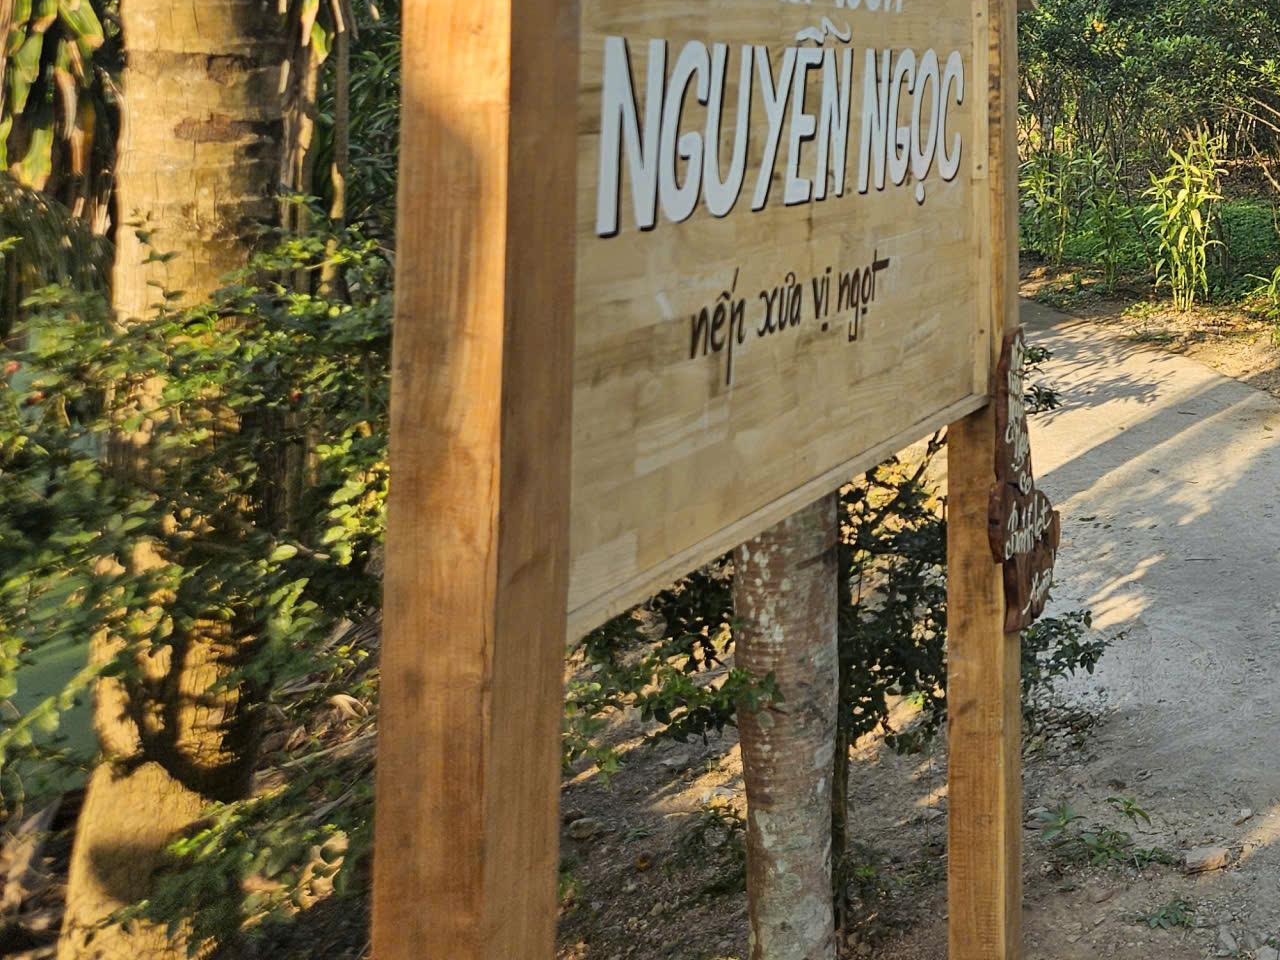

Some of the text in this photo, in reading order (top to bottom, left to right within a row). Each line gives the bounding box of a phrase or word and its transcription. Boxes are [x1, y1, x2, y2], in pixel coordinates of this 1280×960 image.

[596, 16, 965, 238] NGUYỄN NGỌC
[690, 266, 746, 386] nếp
[812, 266, 832, 332] vị
[837, 248, 891, 343] ngọt
